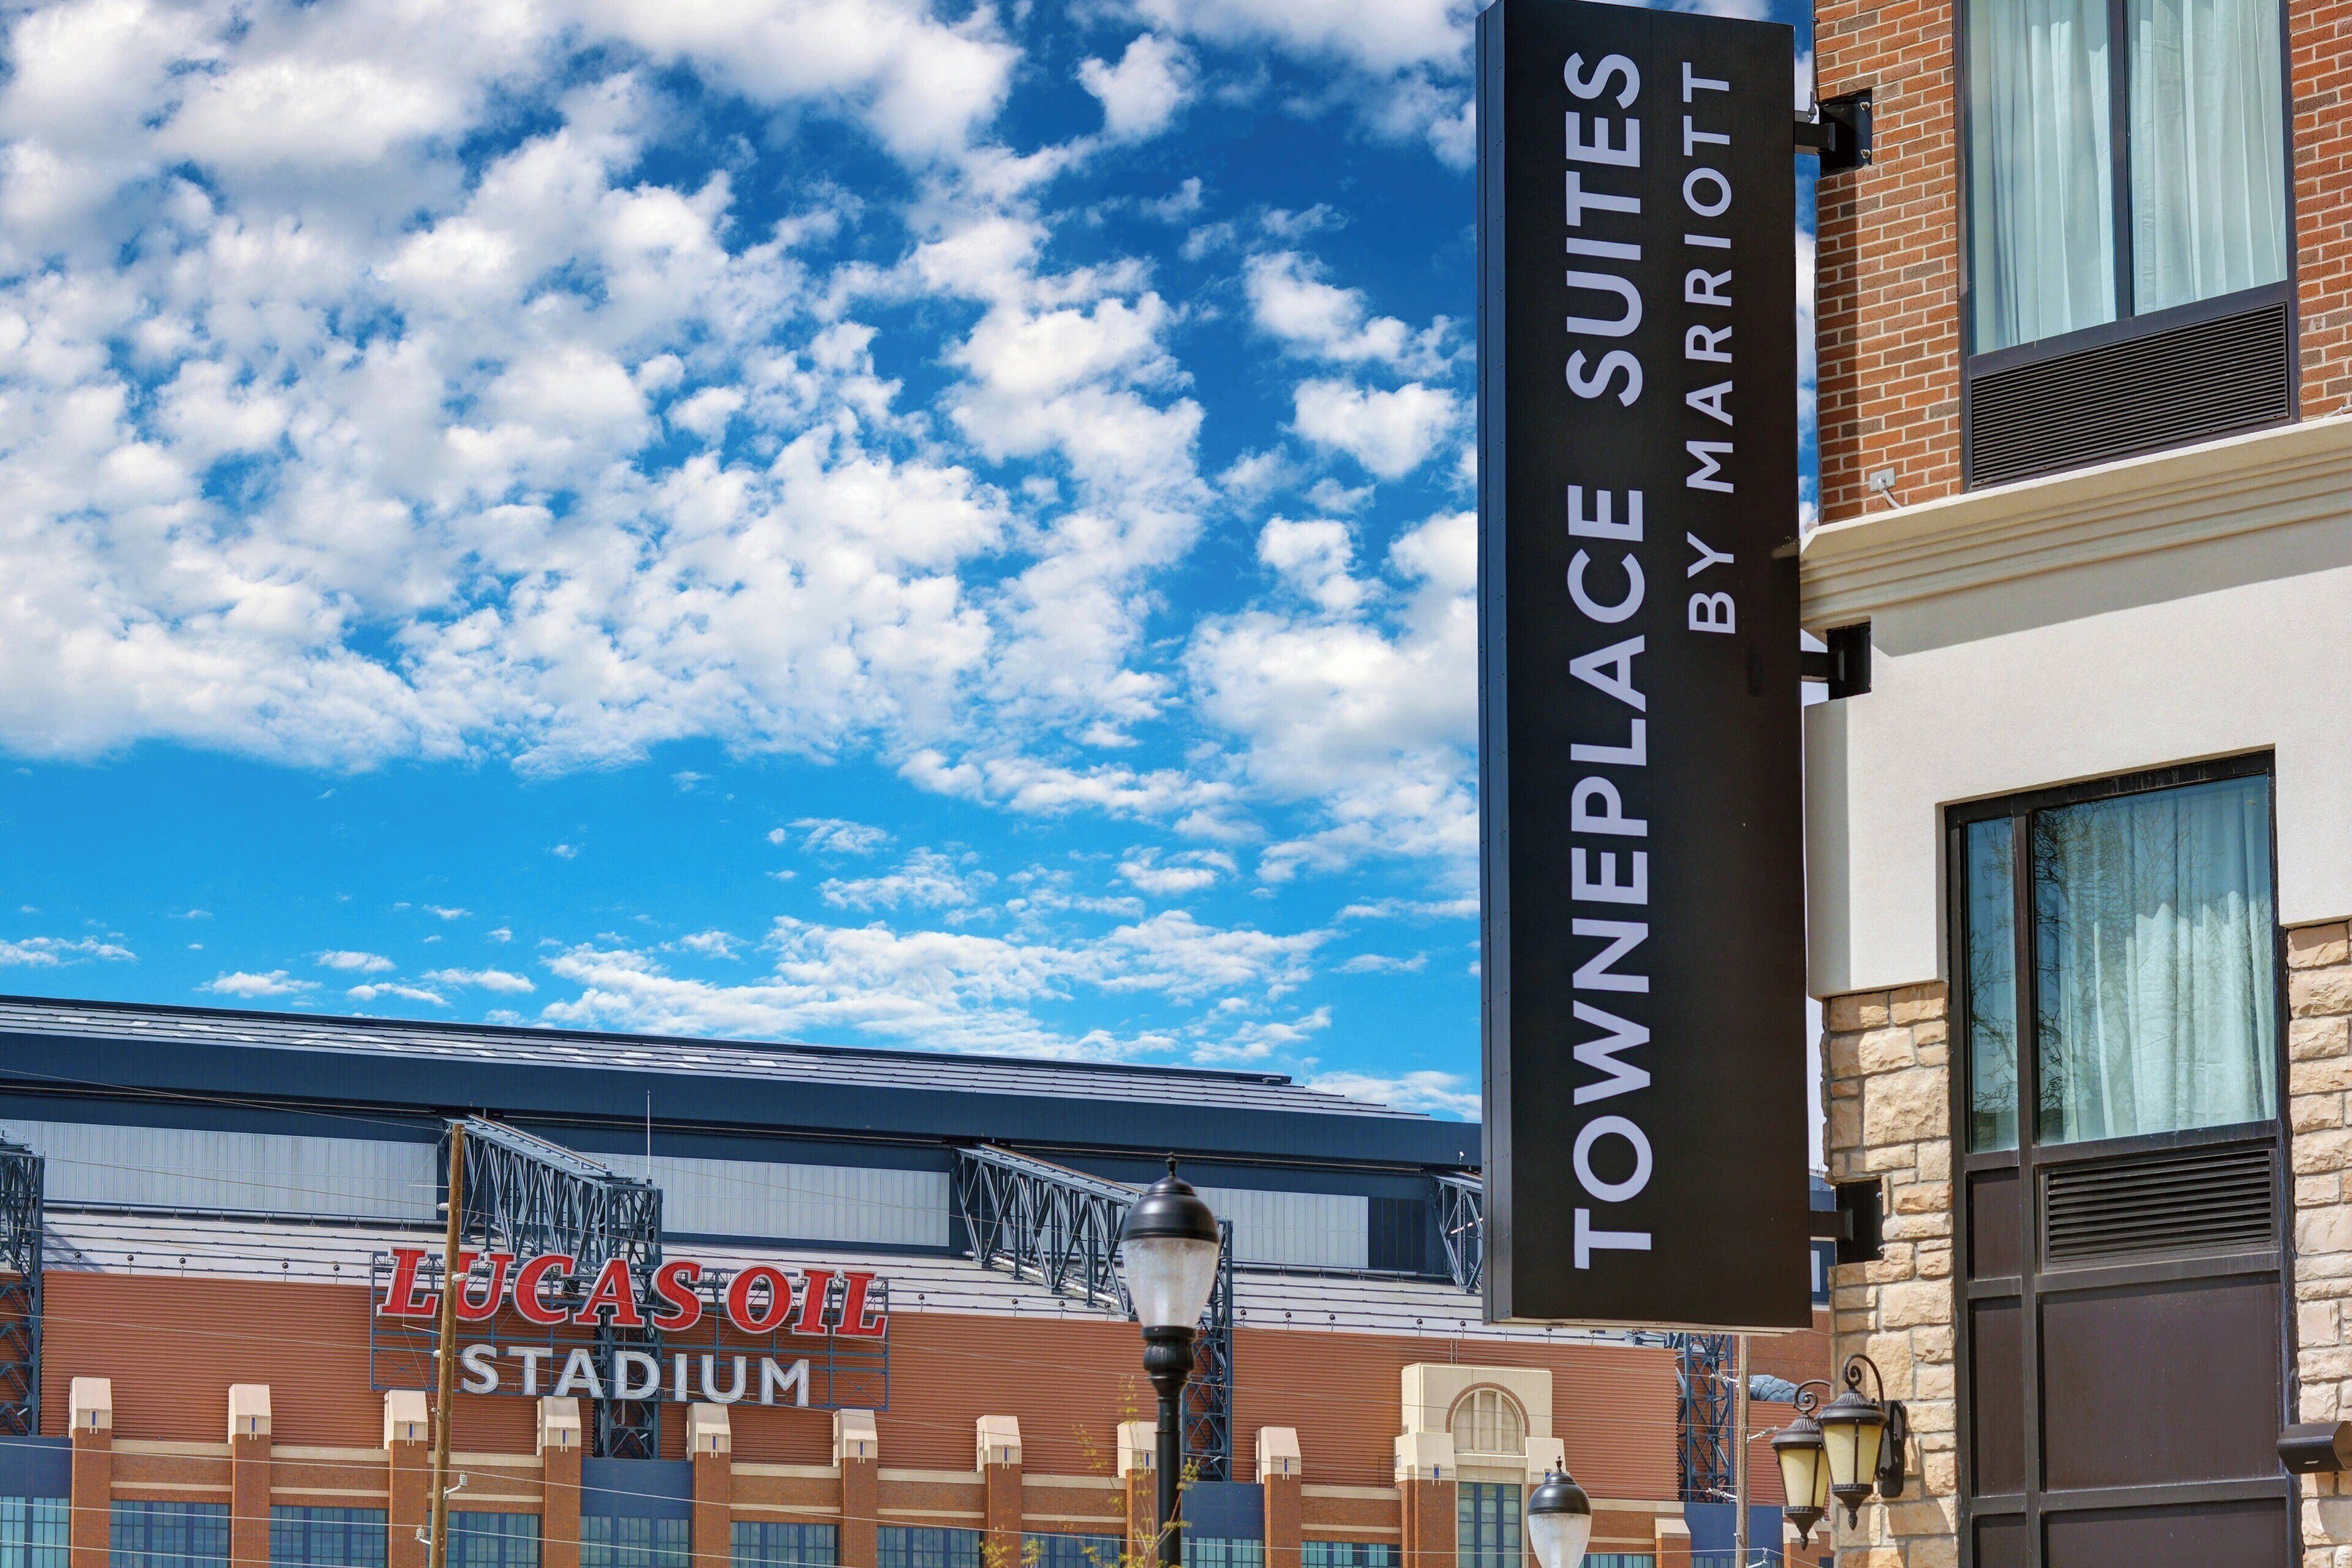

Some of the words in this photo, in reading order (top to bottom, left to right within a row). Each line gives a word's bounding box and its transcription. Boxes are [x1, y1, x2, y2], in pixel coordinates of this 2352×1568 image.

[1563, 51, 1643, 407] SUITES
[1682, 61, 1735, 494] MARRIOTT
[1687, 531, 1735, 635] BY
[1567, 484, 1653, 1270] TOWNEPLACE
[376, 1246, 704, 1332] LUCAS
[723, 1265, 889, 1338] OIL
[461, 1344, 809, 1407] STADIUM
